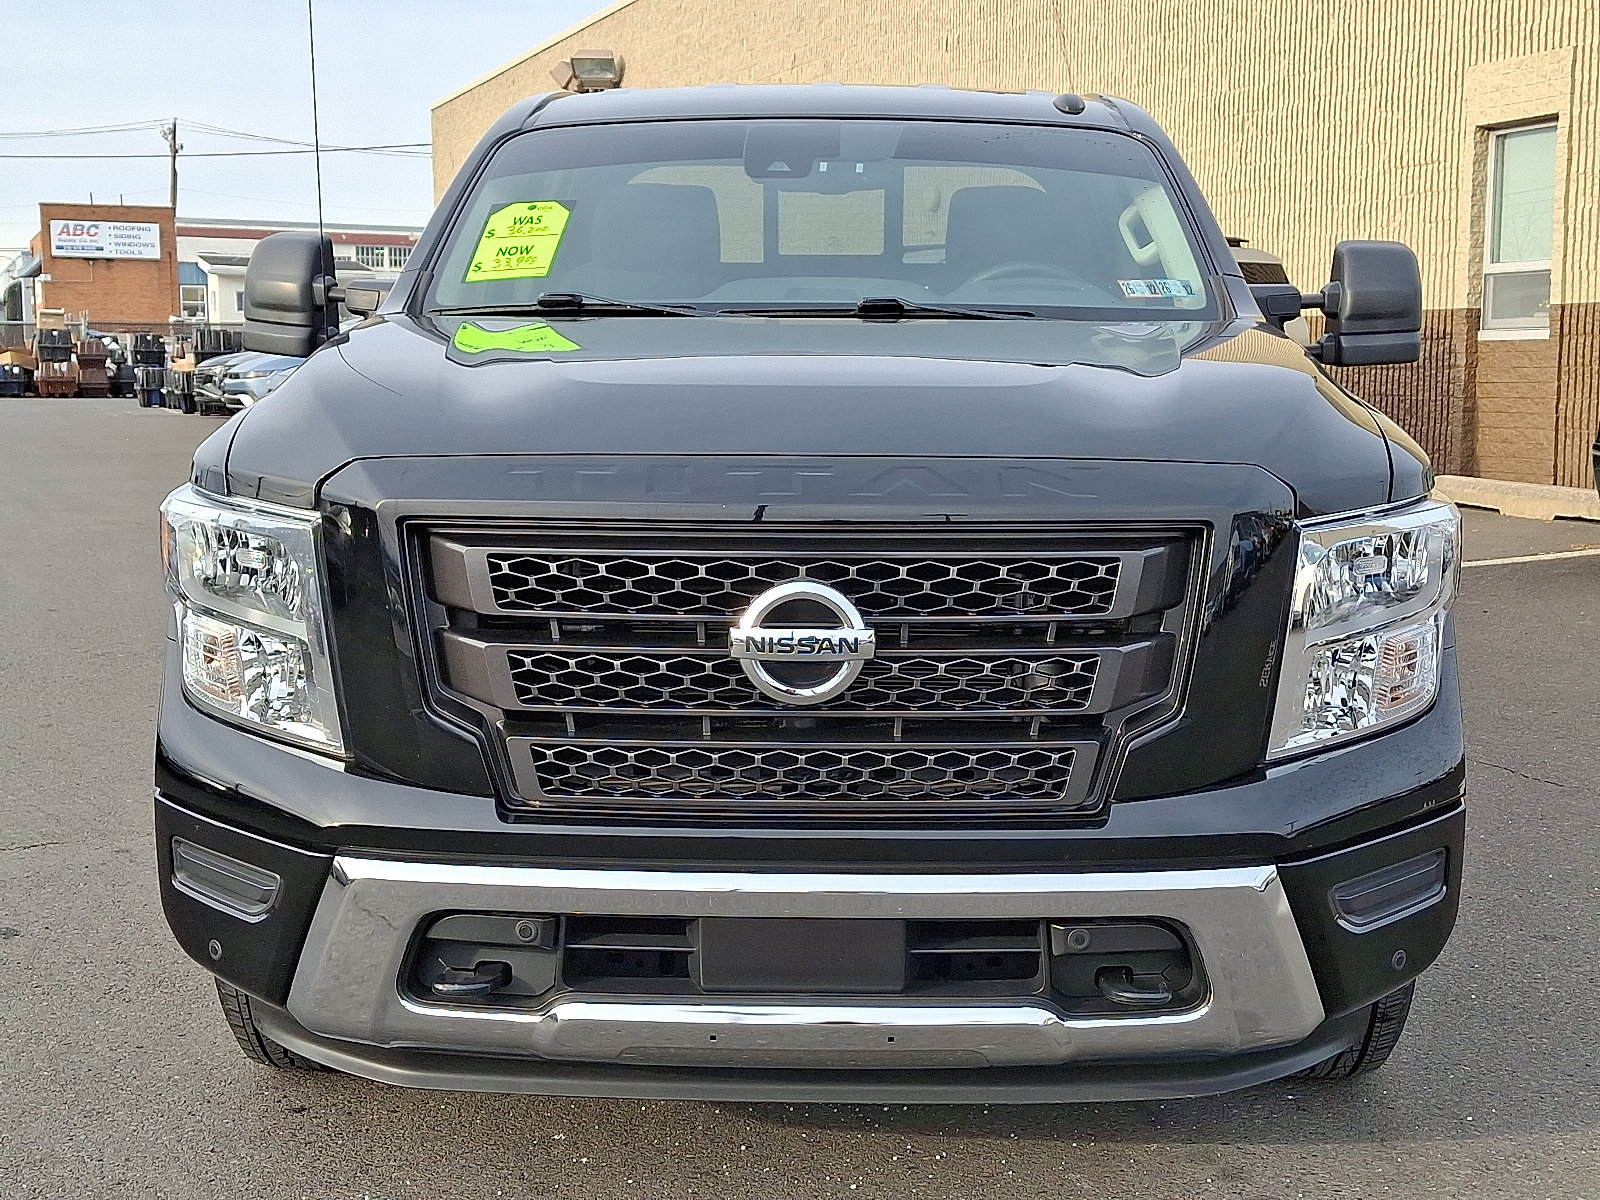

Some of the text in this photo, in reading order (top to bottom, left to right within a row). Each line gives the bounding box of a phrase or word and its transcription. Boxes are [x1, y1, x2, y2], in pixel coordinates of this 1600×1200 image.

[513, 215, 544, 226] WAS
[58, 223, 100, 237] ABC
[485, 228, 496, 239] $
[495, 244, 535, 257] NOW
[472, 261, 483, 273] $
[1121, 282, 1136, 295] 26
[1146, 283, 1160, 295] 12
[1158, 281, 1172, 294] 26
[1182, 284, 1196, 296] 12
[504, 464, 1101, 498] TITAN
[745, 635, 859, 655] NISSAN
